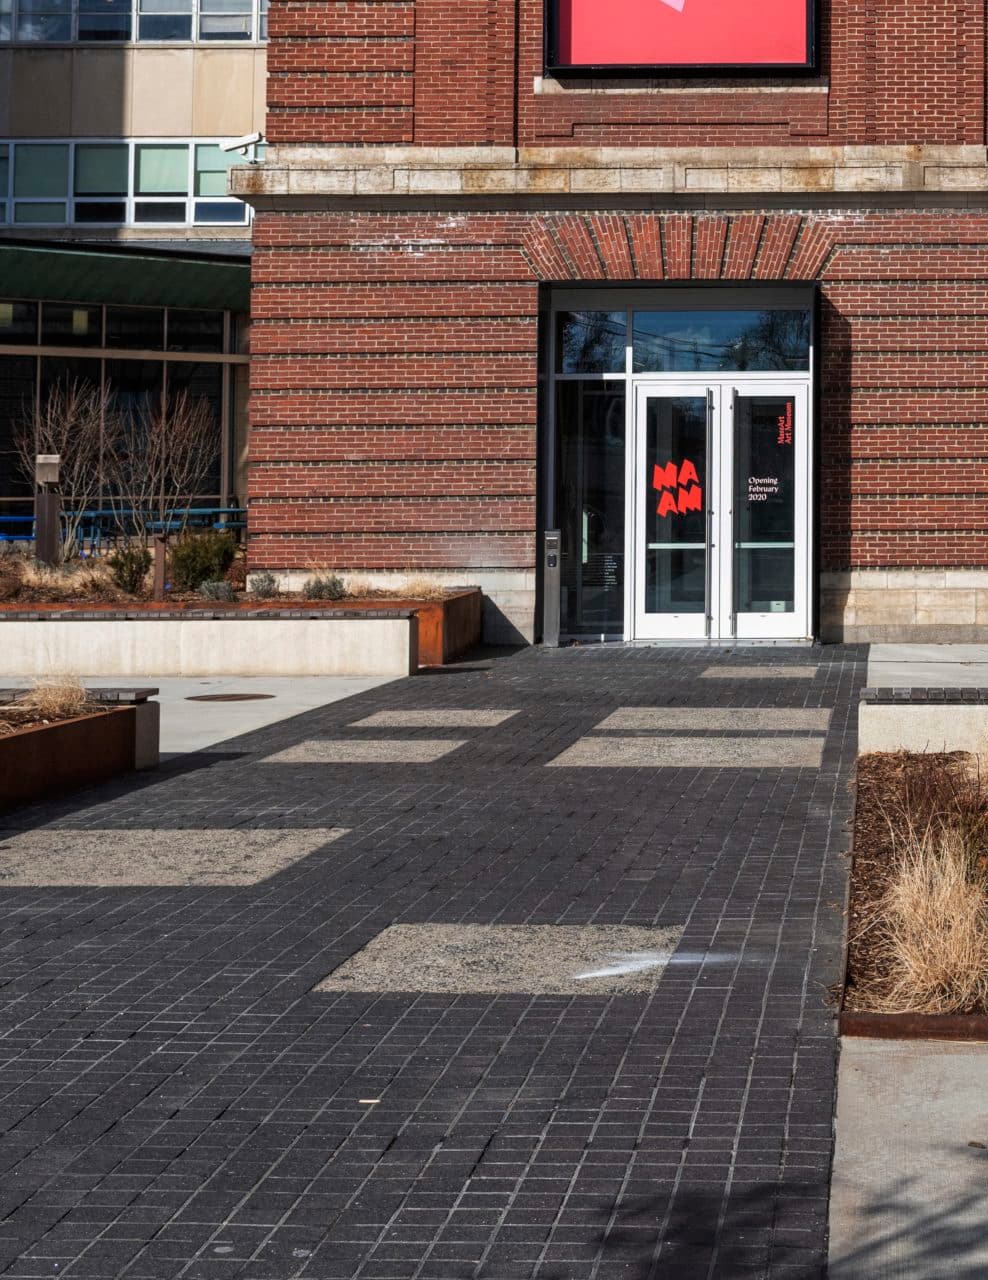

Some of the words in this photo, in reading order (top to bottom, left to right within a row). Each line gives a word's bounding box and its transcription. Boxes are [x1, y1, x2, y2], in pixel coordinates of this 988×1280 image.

[748, 476, 778, 485] Opening
[748, 485, 779, 493] February
[748, 493, 767, 501] 2020
